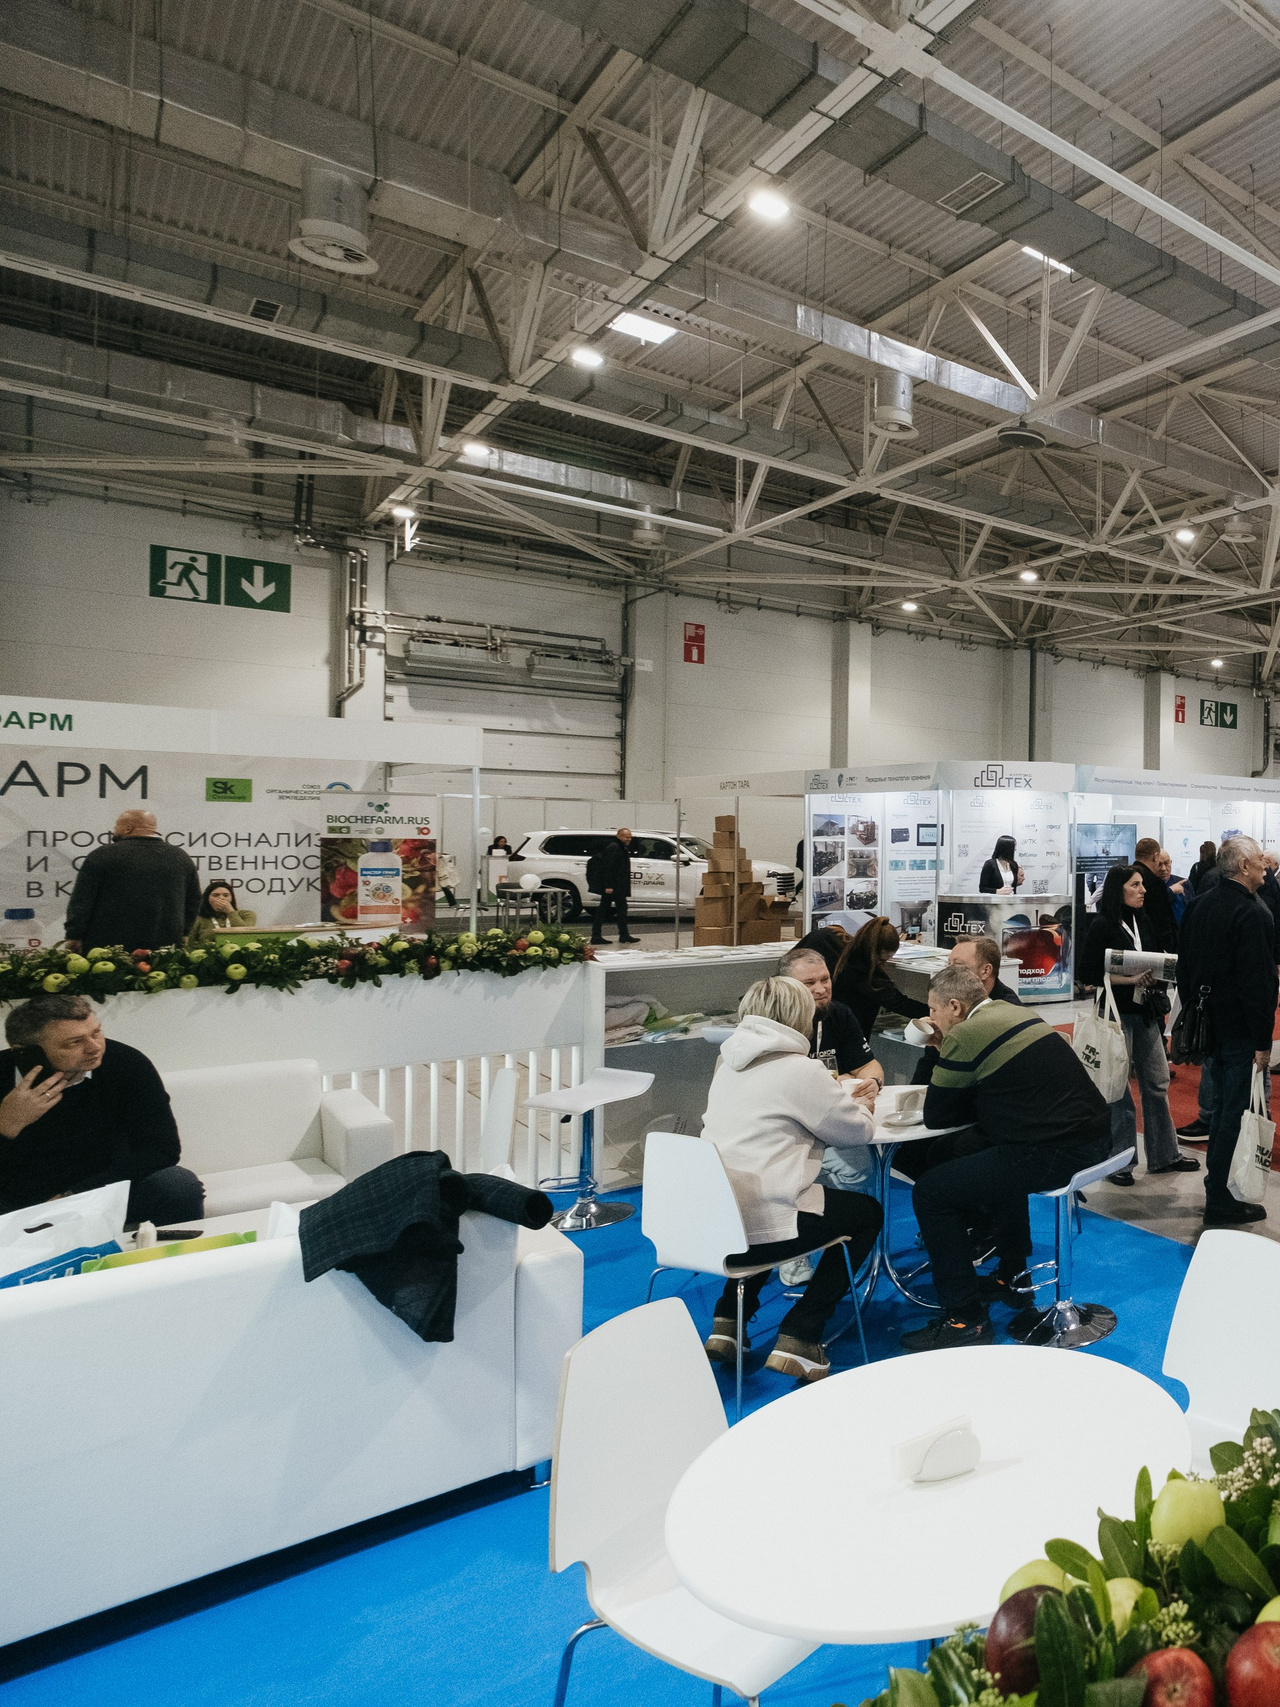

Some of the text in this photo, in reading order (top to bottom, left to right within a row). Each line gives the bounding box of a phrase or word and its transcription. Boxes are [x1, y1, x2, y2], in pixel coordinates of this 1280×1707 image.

[0, 711, 73, 731] АРМ
[0, 760, 148, 799] АРМ
[326, 814, 431, 825] BIOCHEFARM.RUS
[27, 856, 49, 872] И
[27, 881, 45, 898] В
